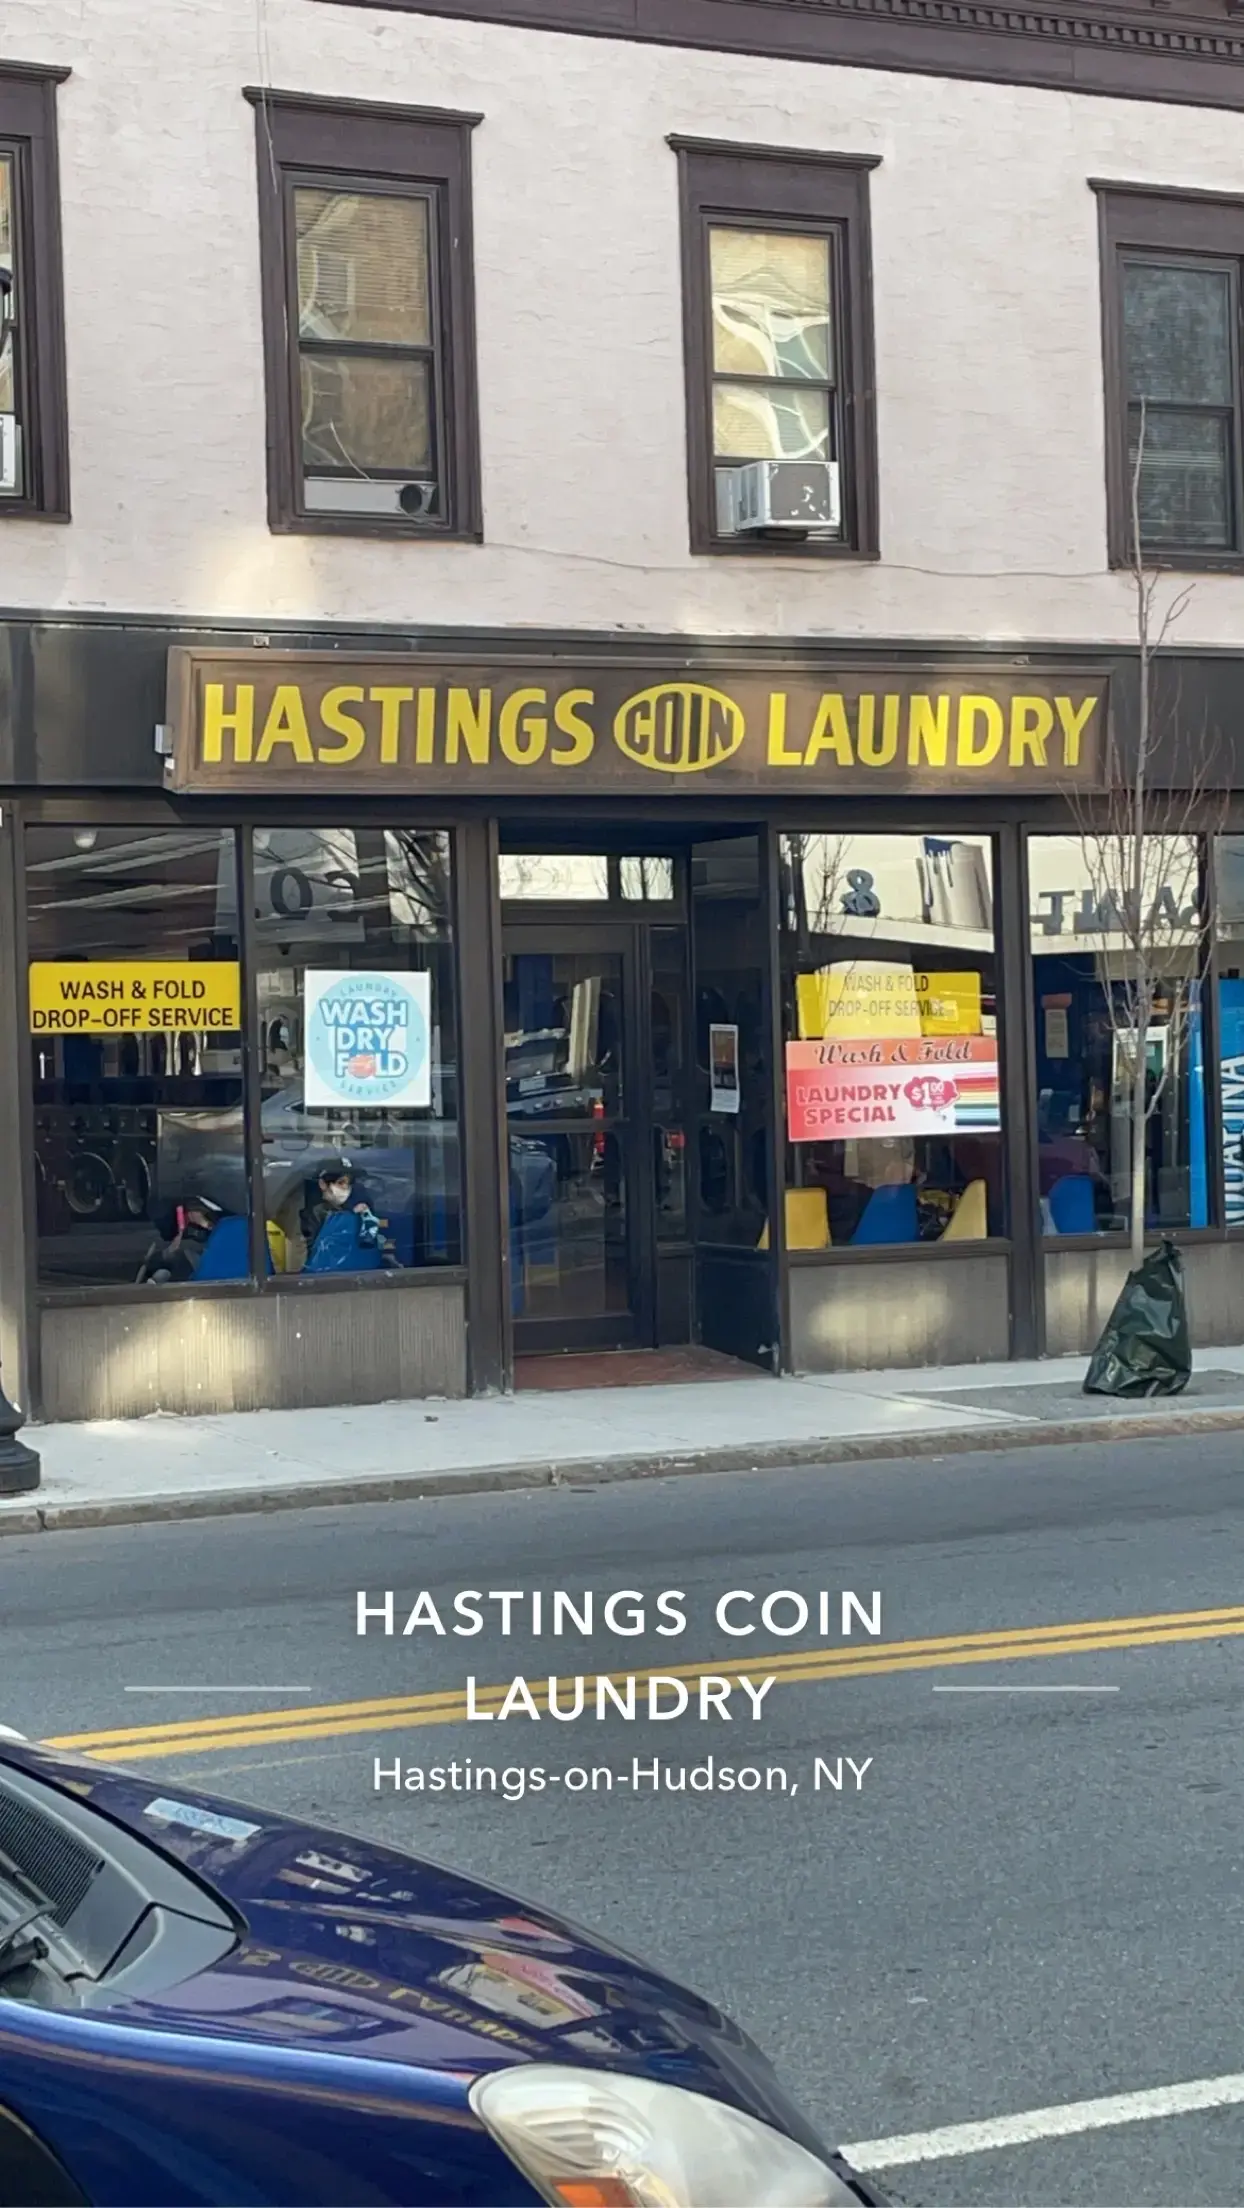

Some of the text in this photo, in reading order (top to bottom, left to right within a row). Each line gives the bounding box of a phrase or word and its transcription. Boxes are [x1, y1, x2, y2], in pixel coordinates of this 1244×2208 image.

[203, 684, 1098, 767] HASTINGS COIN LAUNDRY
[60, 980, 206, 1000] WASH & FOLD
[844, 975, 929, 991] WASH & FOLD
[33, 1007, 233, 1029] DROP-OFF SERVICE
[319, 998, 408, 1027] WASH
[829, 1000, 945, 1016] DROP-OFF SERVICE
[335, 1026, 395, 1052] DRY
[814, 1041, 971, 1065] Wash & Fold
[796, 1083, 902, 1104] LAUNDRY
[805, 1105, 896, 1125] SPECIAL
